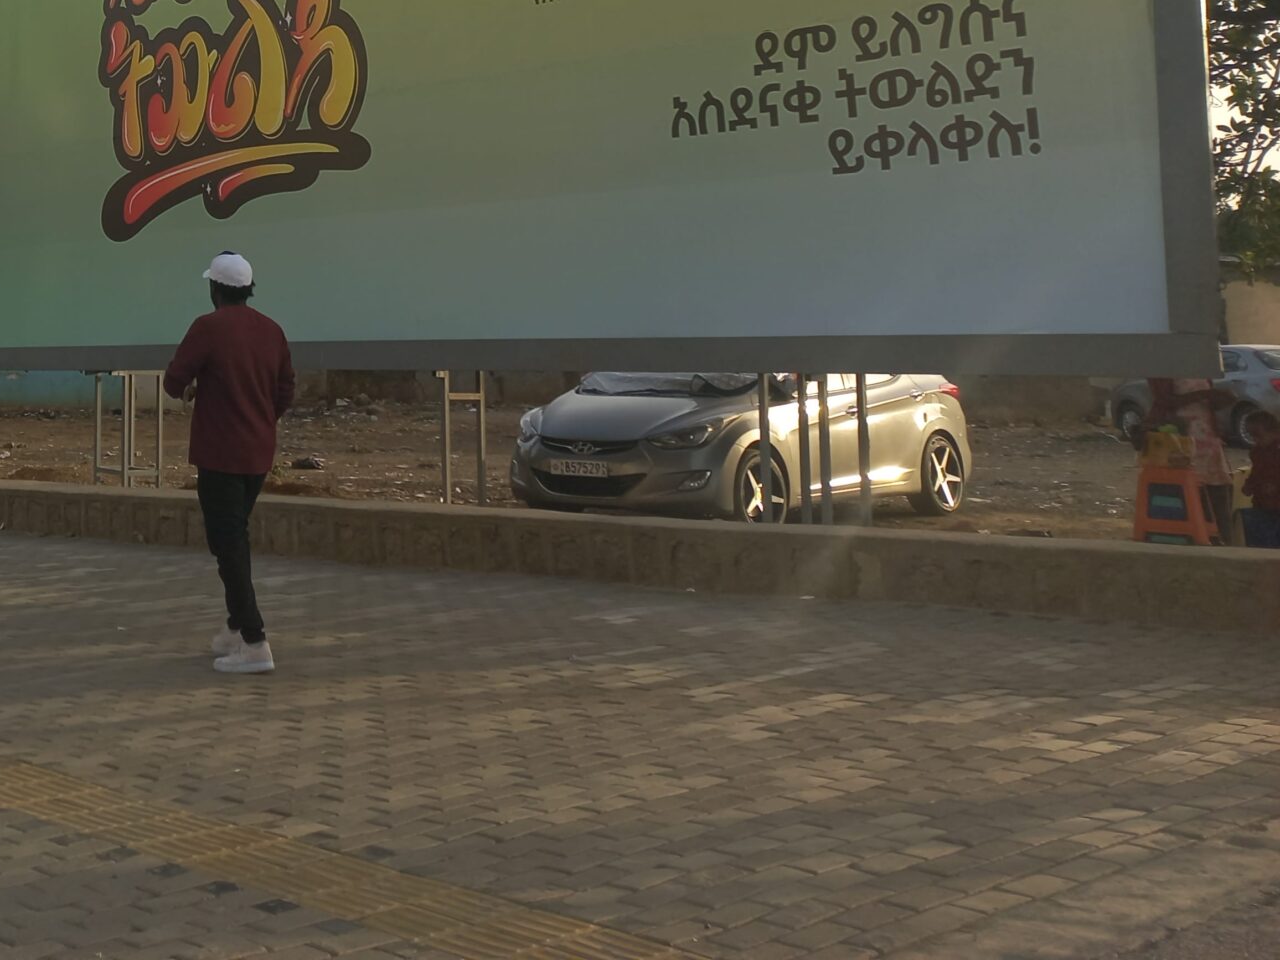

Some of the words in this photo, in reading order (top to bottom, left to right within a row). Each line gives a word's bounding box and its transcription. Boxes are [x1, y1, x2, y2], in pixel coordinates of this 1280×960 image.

[753, 23, 837, 76] ደም
[671, 79, 822, 138] አስደናቂ
[834, 47, 1035, 118] ትውልድን
[827, 106, 1042, 176] ይቀላቀሉ!
